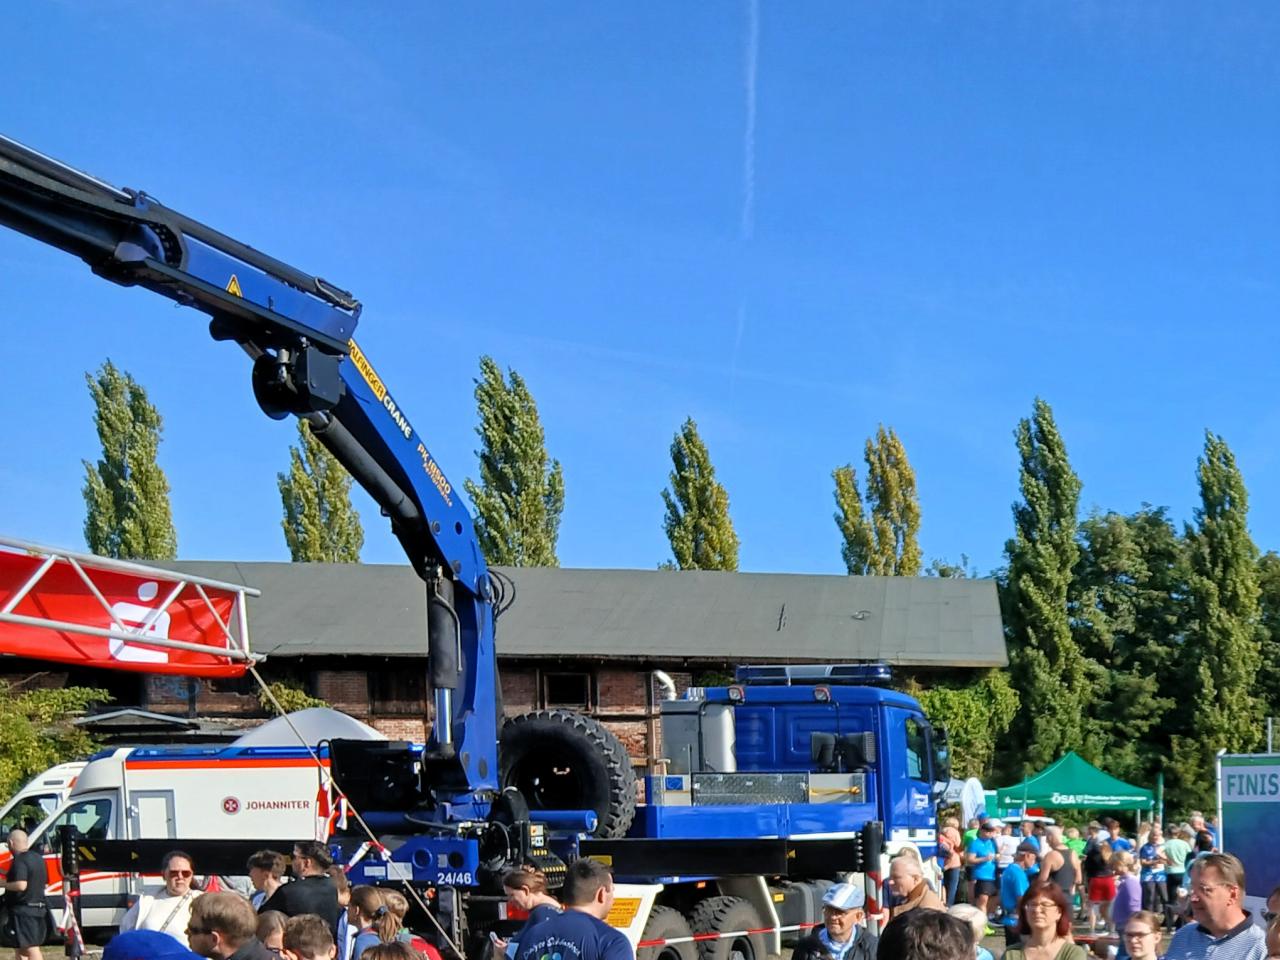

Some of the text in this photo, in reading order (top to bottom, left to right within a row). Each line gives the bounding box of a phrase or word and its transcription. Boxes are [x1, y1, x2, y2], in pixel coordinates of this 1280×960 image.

[383, 395, 412, 438] CRANE
[417, 443, 430, 462] PK
[1051, 792, 1076, 804] ÖSA
[245, 800, 310, 810] JOHANNITER
[437, 872, 472, 885] 24/46
